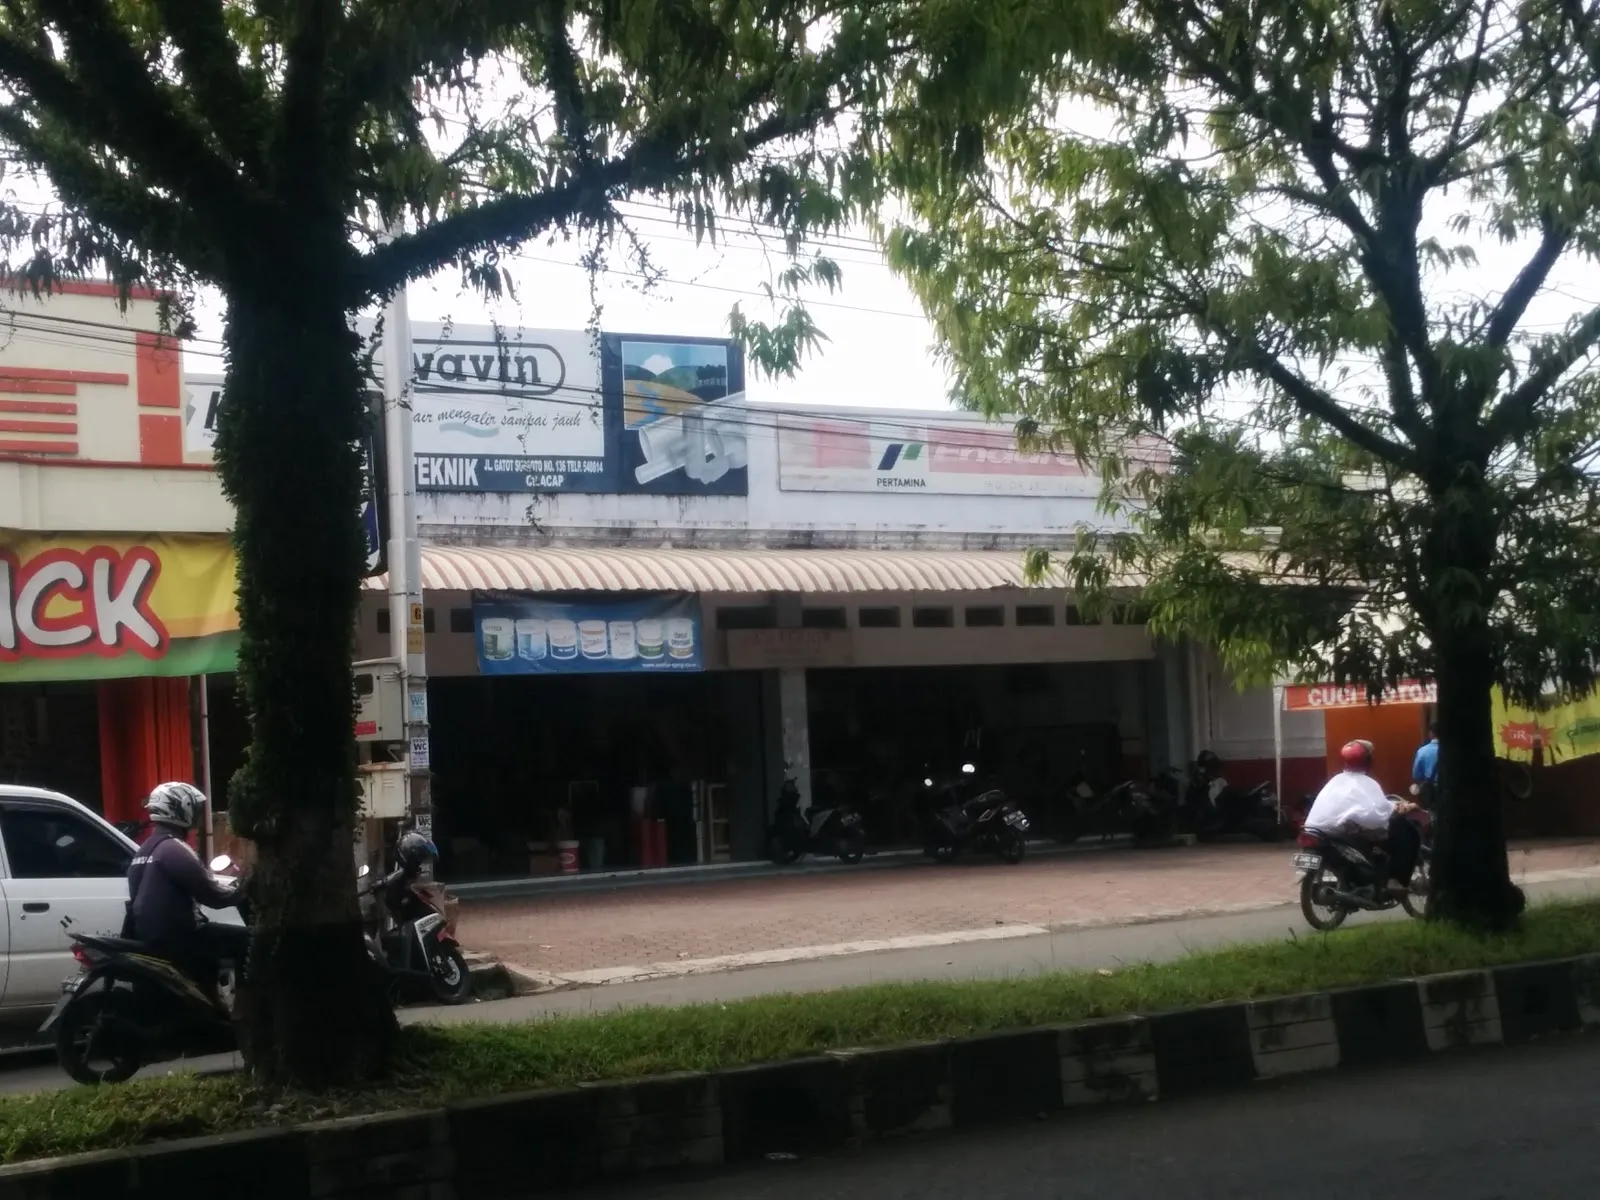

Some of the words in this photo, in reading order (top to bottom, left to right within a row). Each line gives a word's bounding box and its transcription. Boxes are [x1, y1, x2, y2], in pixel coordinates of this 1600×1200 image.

[437, 409, 496, 426] mengalir
[501, 412, 547, 429] sampai
[552, 411, 581, 431] jauh
[414, 457, 478, 486] EKNIK
[494, 459, 514, 472] GATOT
[876, 477, 926, 487] PERTAMINA
[1308, 686, 1357, 706] CUCI
[413, 742, 427, 751] WC
